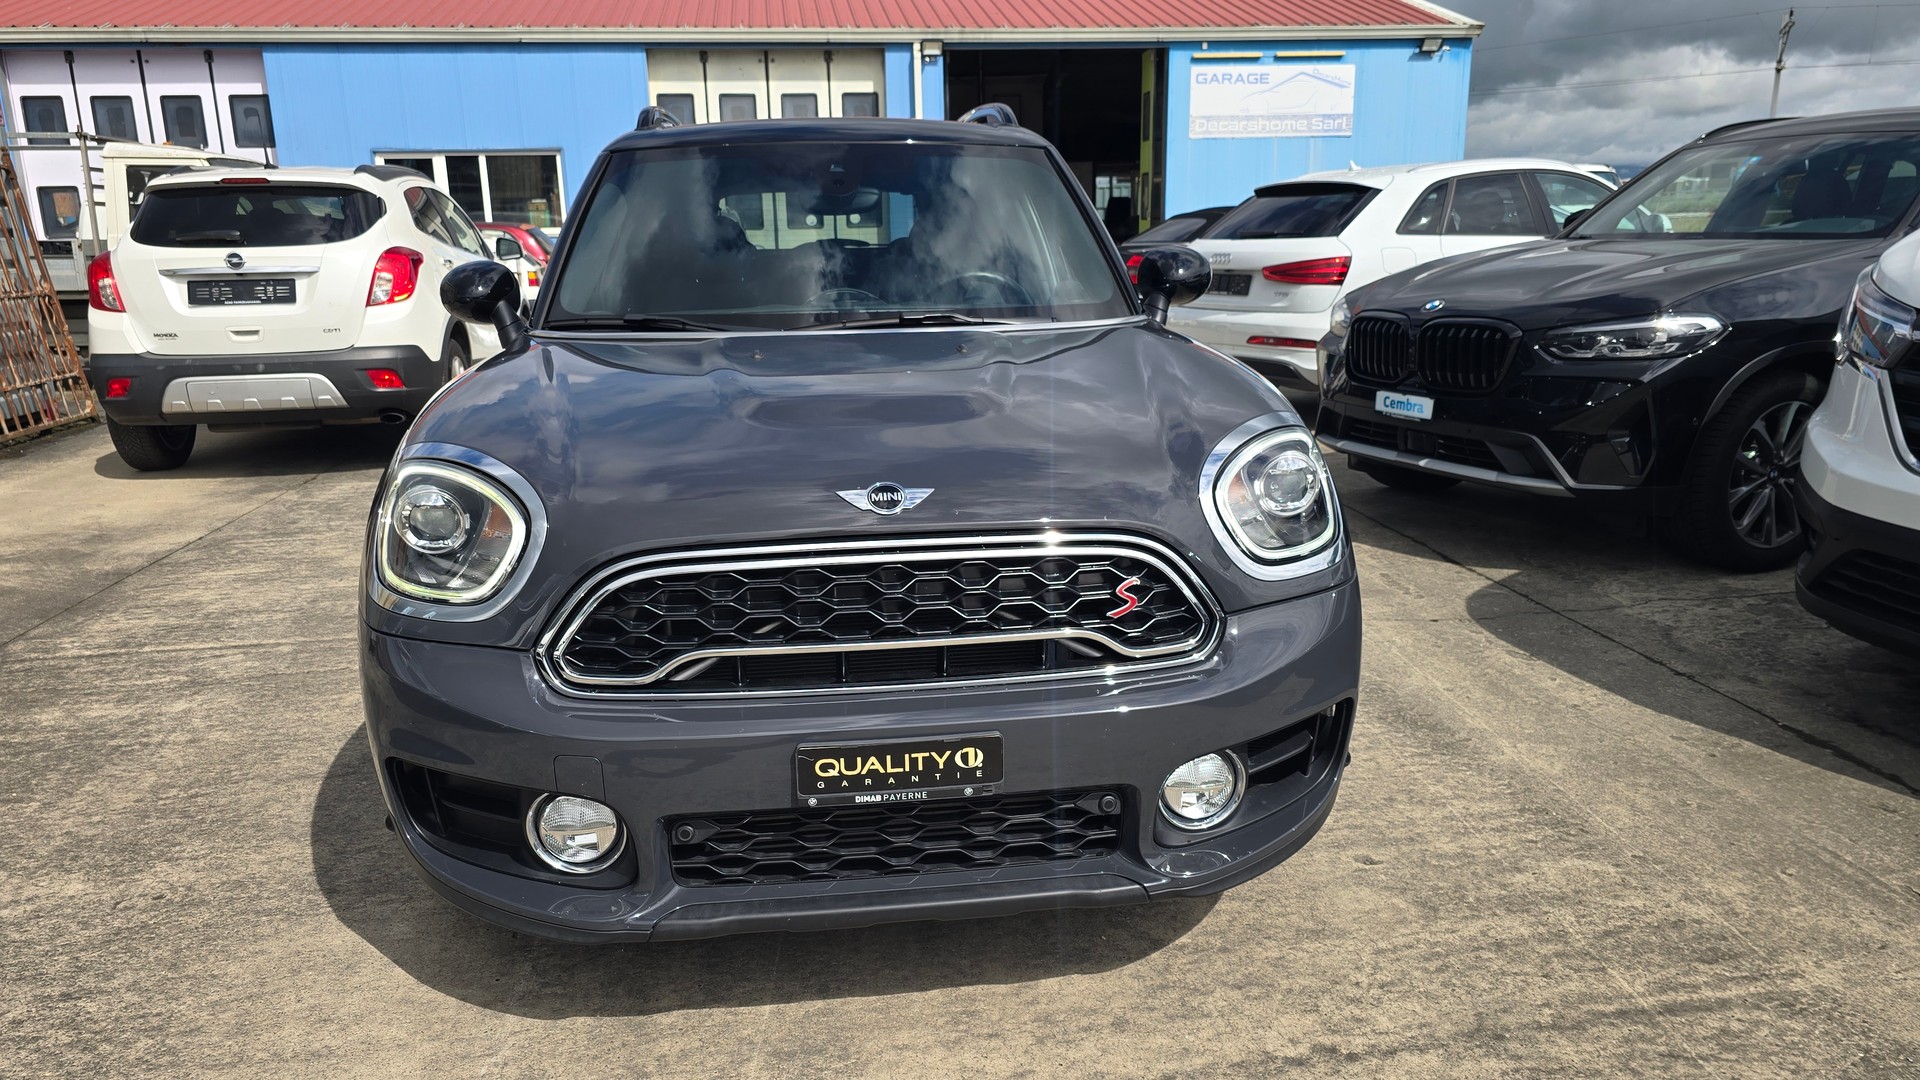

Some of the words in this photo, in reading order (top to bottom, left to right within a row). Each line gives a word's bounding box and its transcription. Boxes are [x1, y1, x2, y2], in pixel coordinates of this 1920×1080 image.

[1195, 73, 1270, 85] GARAGE
[1195, 118, 1308, 132] Decarshome
[1383, 395, 1424, 414] Cembra
[871, 492, 902, 502] MINI
[1106, 576, 1141, 619] S
[814, 750, 952, 777] QUALITY
[817, 770, 983, 789] GARANTIE
[855, 794, 882, 803] DIMAB
[883, 791, 928, 802] PAYERNE
